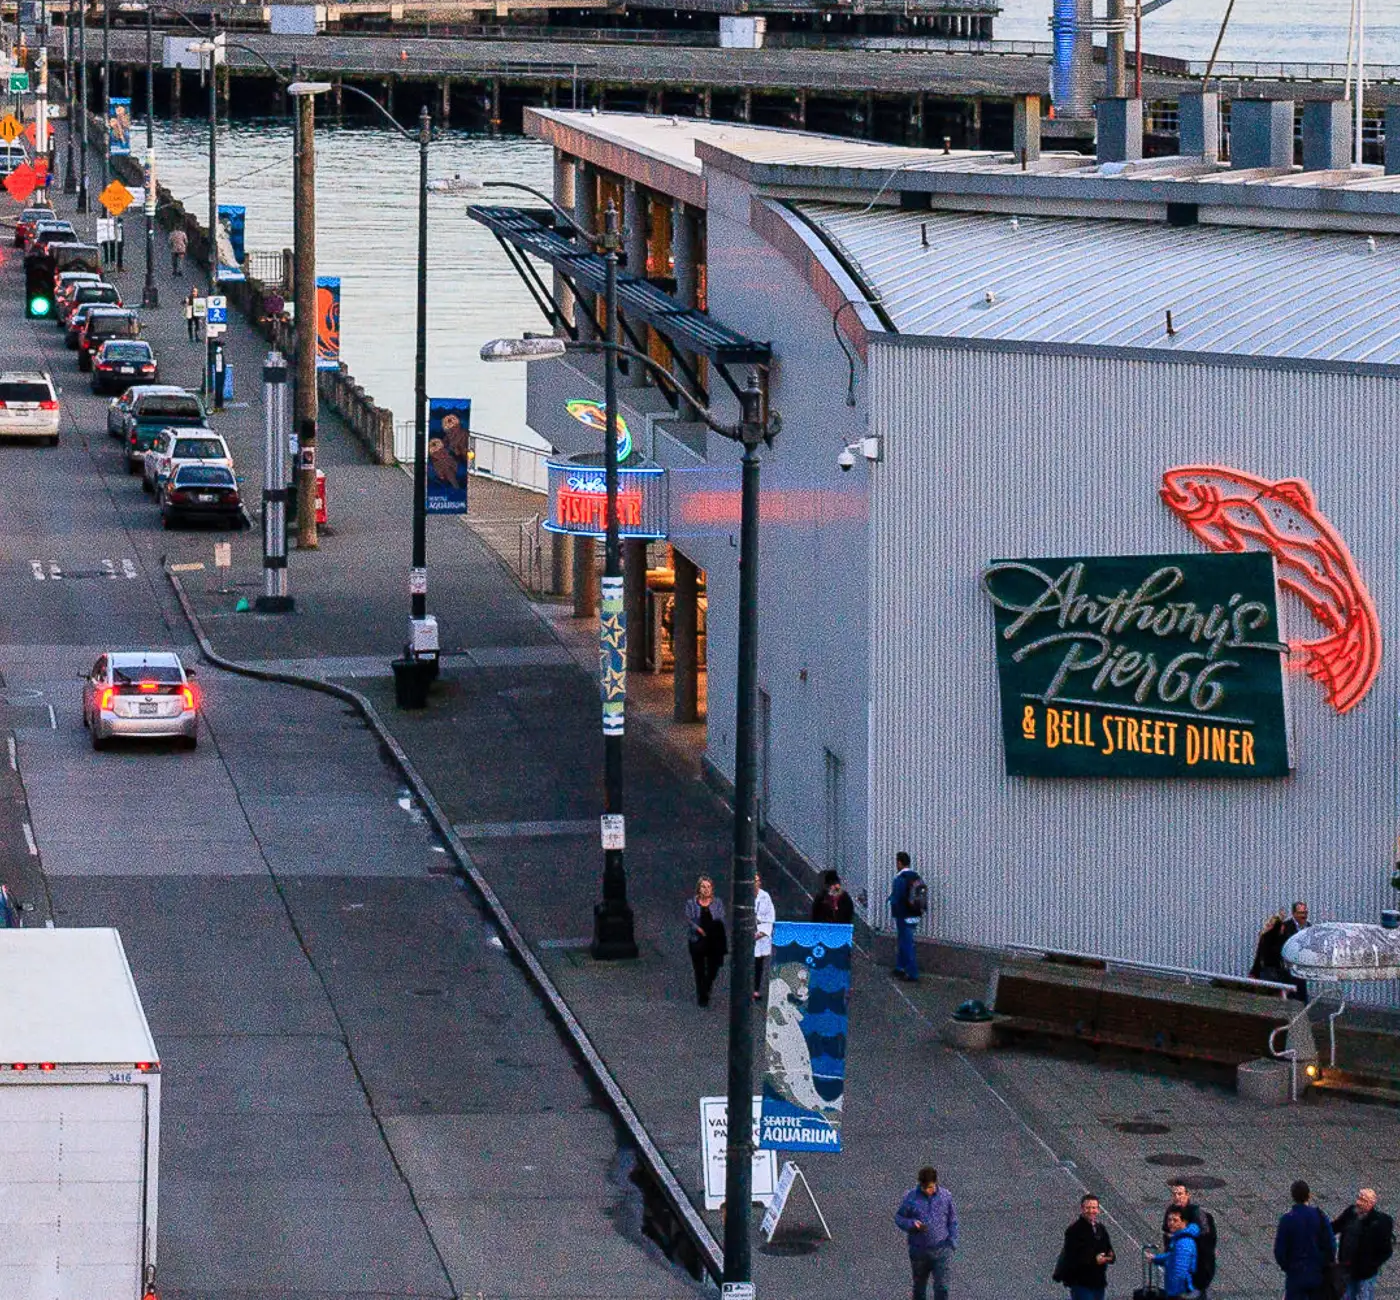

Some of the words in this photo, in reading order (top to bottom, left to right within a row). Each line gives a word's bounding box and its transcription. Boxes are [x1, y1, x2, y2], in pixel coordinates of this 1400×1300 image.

[980, 561, 1290, 661] Anthony's
[1022, 705, 1036, 739] &
[1046, 707, 1095, 749] BELL
[1101, 714, 1178, 756] STREET
[1185, 723, 1256, 766] DINER
[763, 1126, 838, 1144] AQUARIUM
